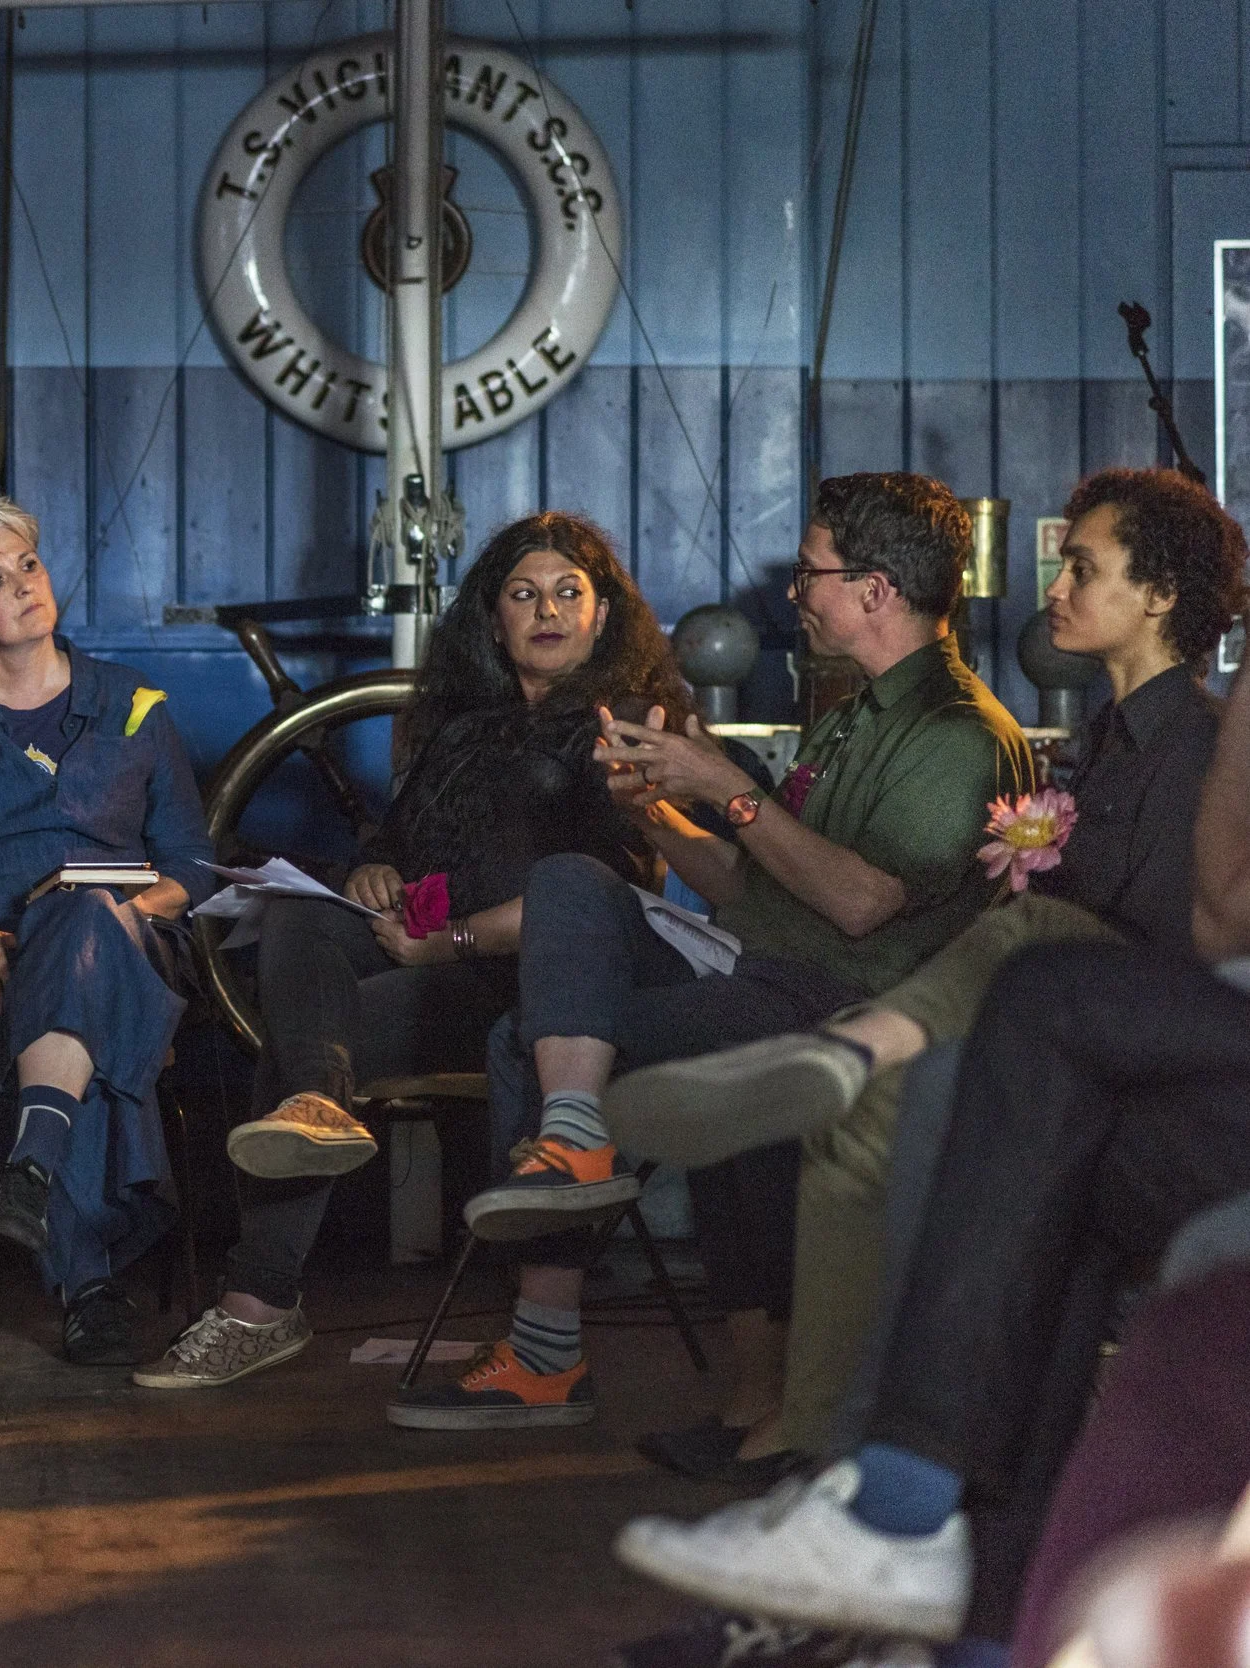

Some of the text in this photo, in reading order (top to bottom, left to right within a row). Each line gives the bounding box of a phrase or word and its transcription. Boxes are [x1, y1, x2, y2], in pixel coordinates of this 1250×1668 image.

[216, 53, 603, 231] T.S. VIGIANT S.C.C.
[237, 309, 577, 431] WHITABLE
